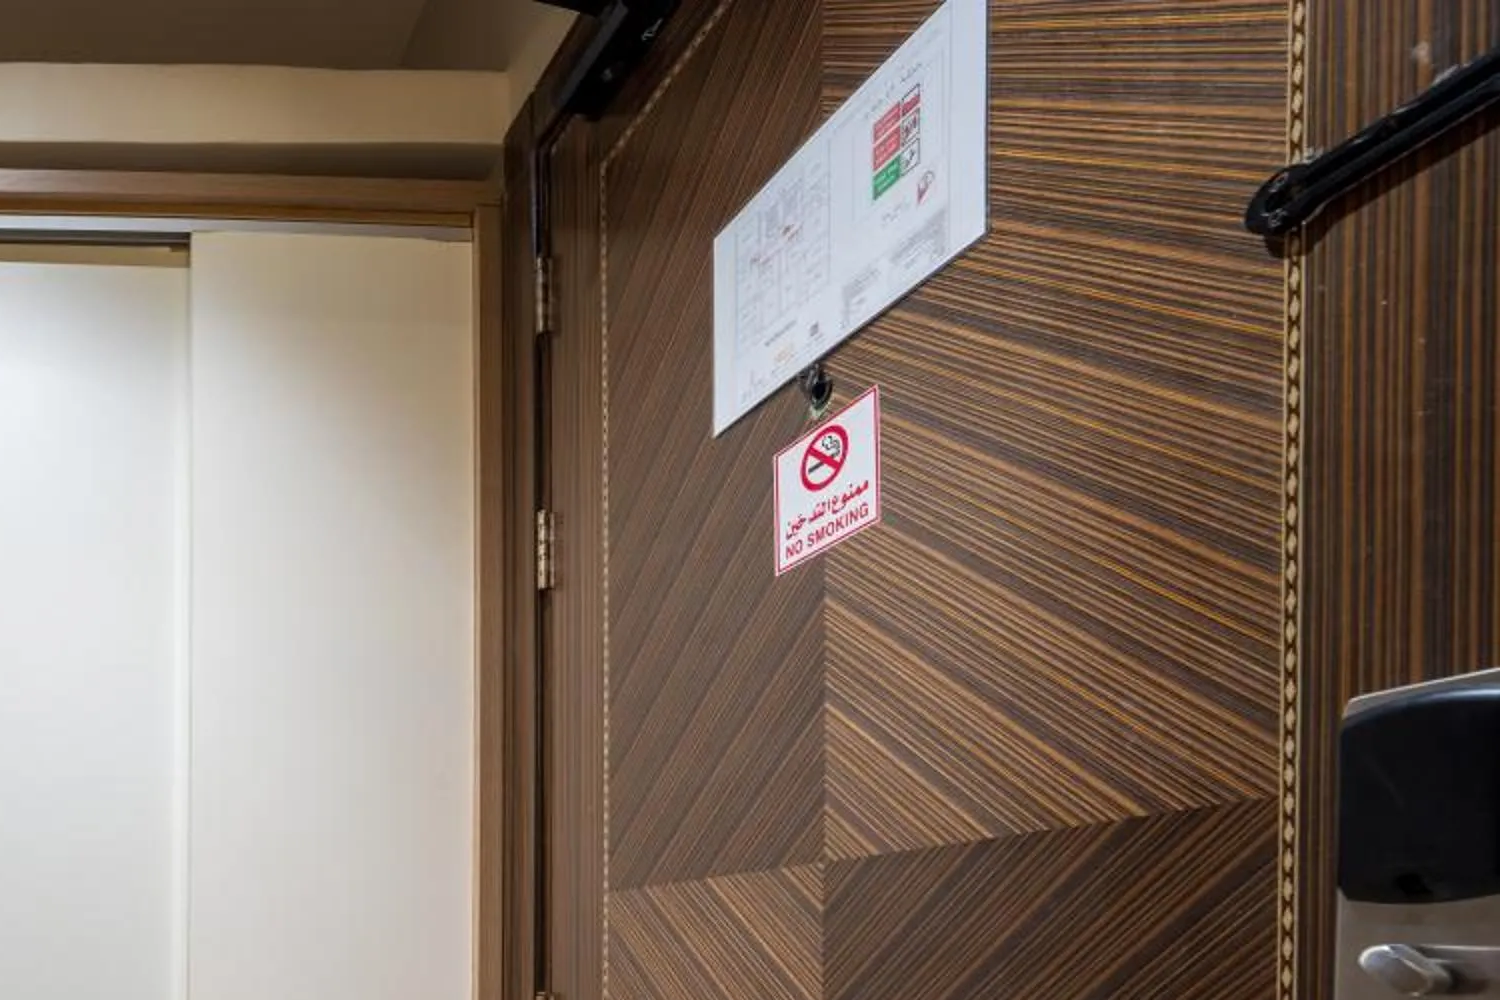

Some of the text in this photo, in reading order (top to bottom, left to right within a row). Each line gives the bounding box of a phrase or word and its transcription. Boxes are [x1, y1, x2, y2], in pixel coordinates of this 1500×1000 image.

[786, 479, 869, 540] ممنوع التدخين
[786, 503, 869, 560] NO SMOKING
